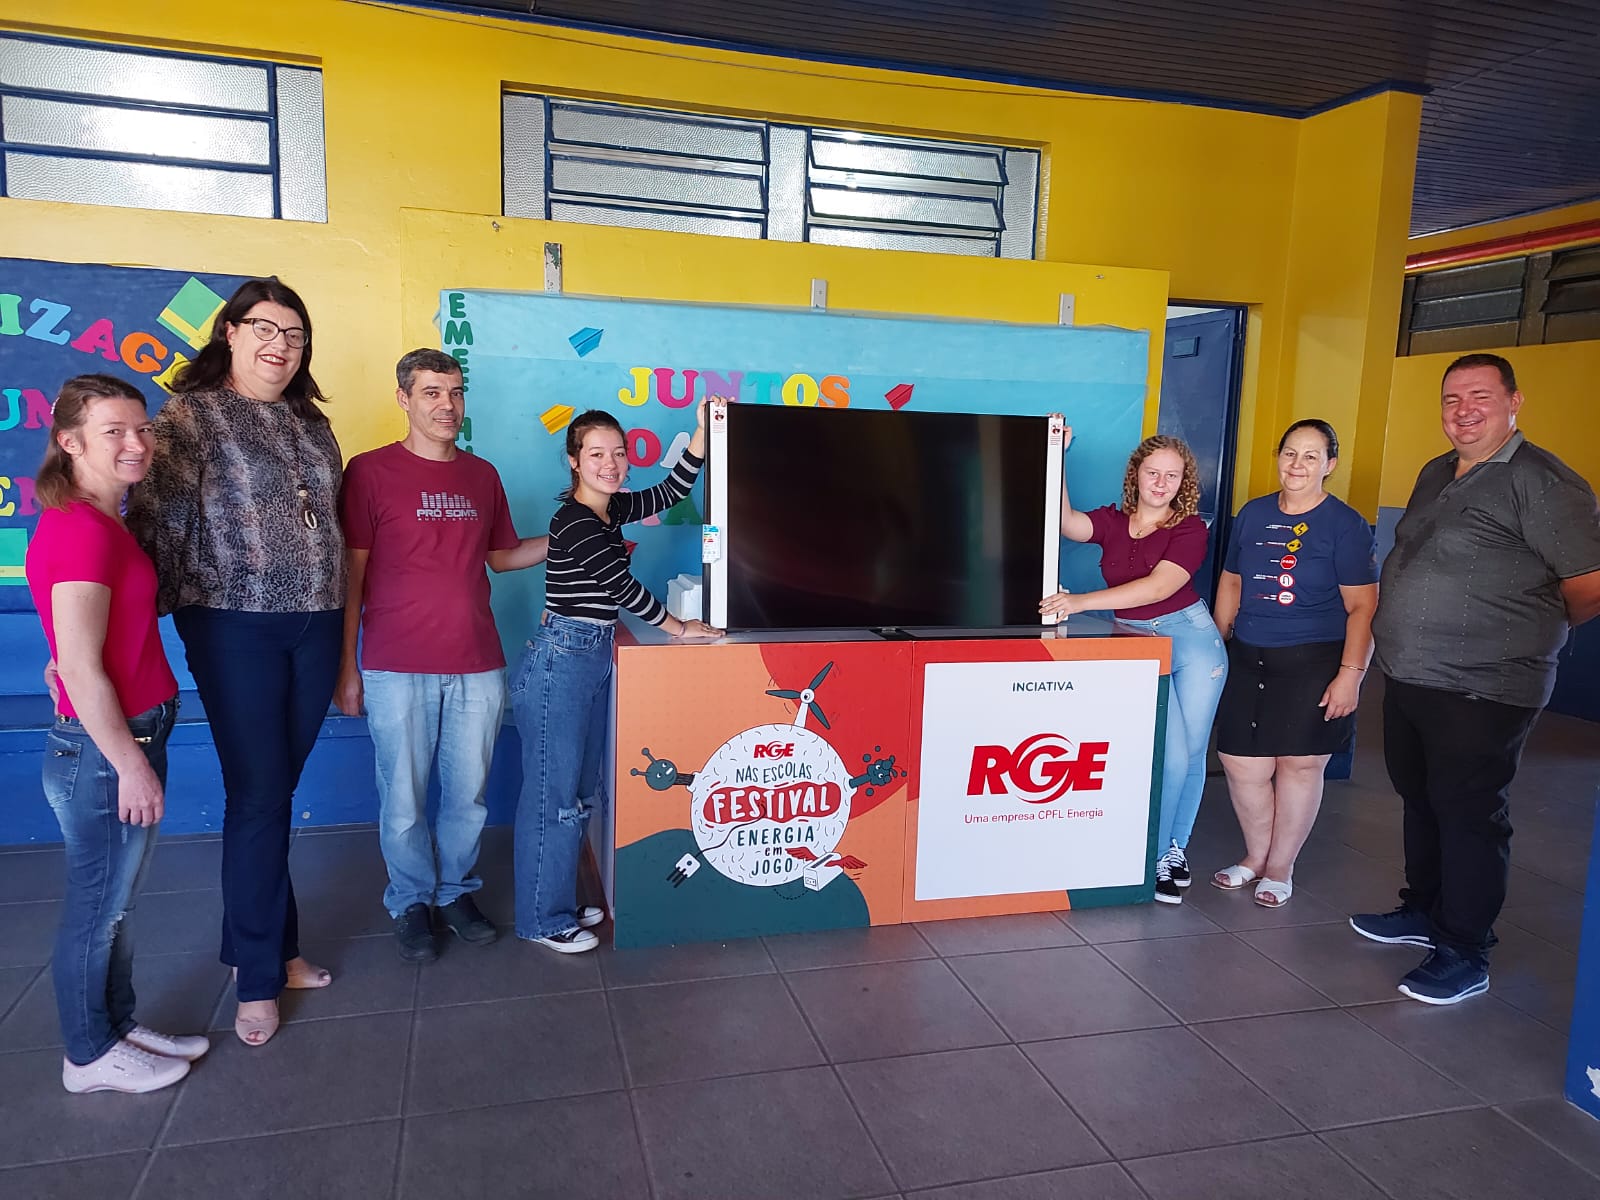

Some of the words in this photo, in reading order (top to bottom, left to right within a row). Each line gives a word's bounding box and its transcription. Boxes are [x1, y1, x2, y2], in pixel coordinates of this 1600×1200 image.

[618, 367, 851, 409] JUNTOS
[1012, 681, 1074, 692] INCIATIVA
[754, 741, 794, 760] RGE
[736, 765, 759, 783] NAS
[763, 761, 812, 784] ESCOLAS
[967, 733, 1110, 803] RGE
[712, 786, 830, 823] FESTIVAL
[964, 814, 989, 824] Uma
[992, 812, 1035, 823] empresa
[1038, 809, 1064, 820] CPFL
[1067, 807, 1104, 819] Energia
[737, 825, 814, 846] ENERGIA
[751, 857, 793, 876] JOGO
